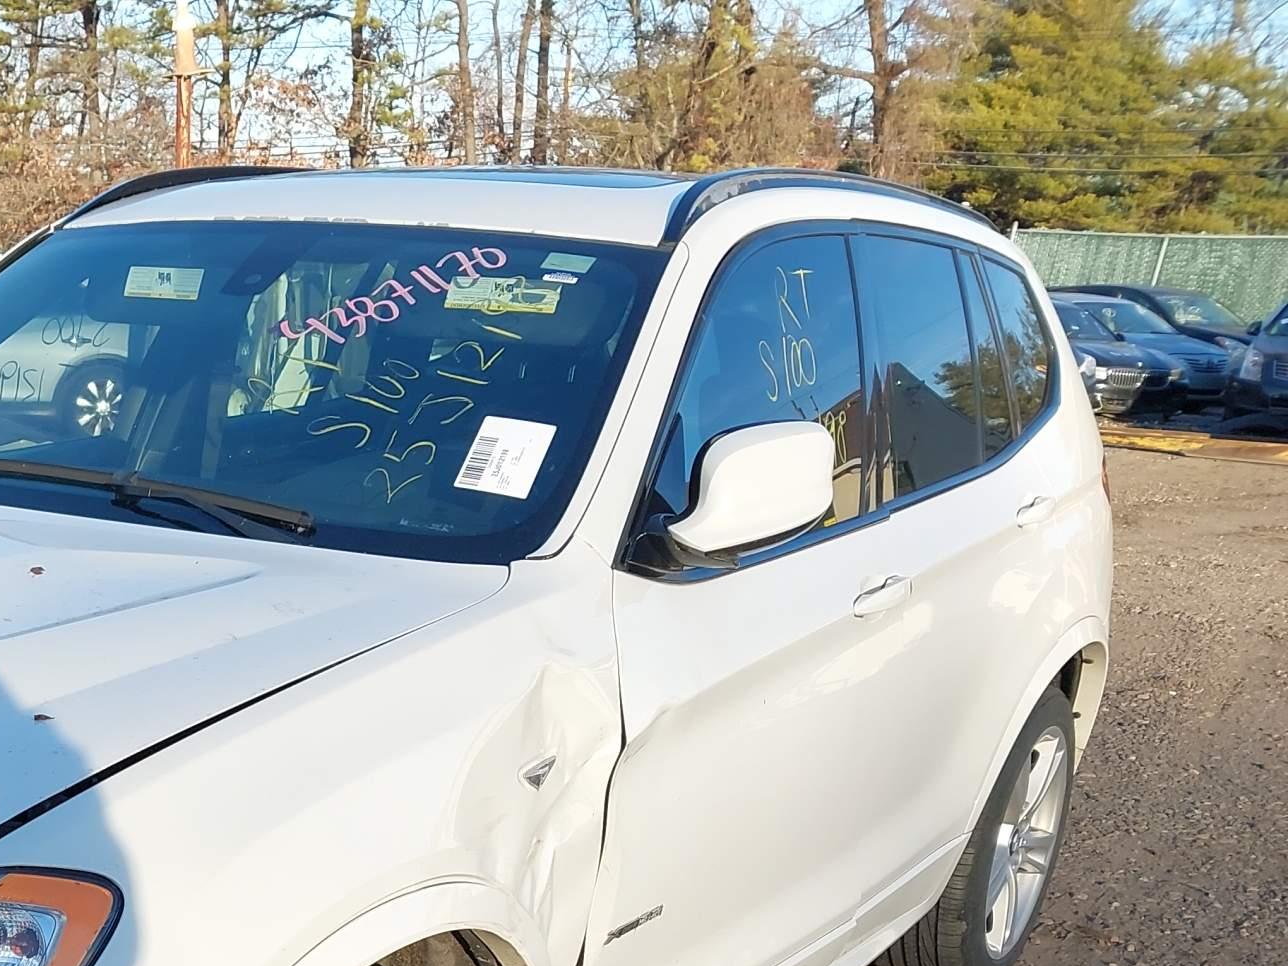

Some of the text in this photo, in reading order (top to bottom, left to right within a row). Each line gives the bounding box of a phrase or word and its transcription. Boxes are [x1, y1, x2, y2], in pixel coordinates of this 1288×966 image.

[280, 246, 508, 344] 43871170
[775, 266, 815, 333] RT
[307, 358, 420, 449] S100
[758, 335, 817, 402] S100
